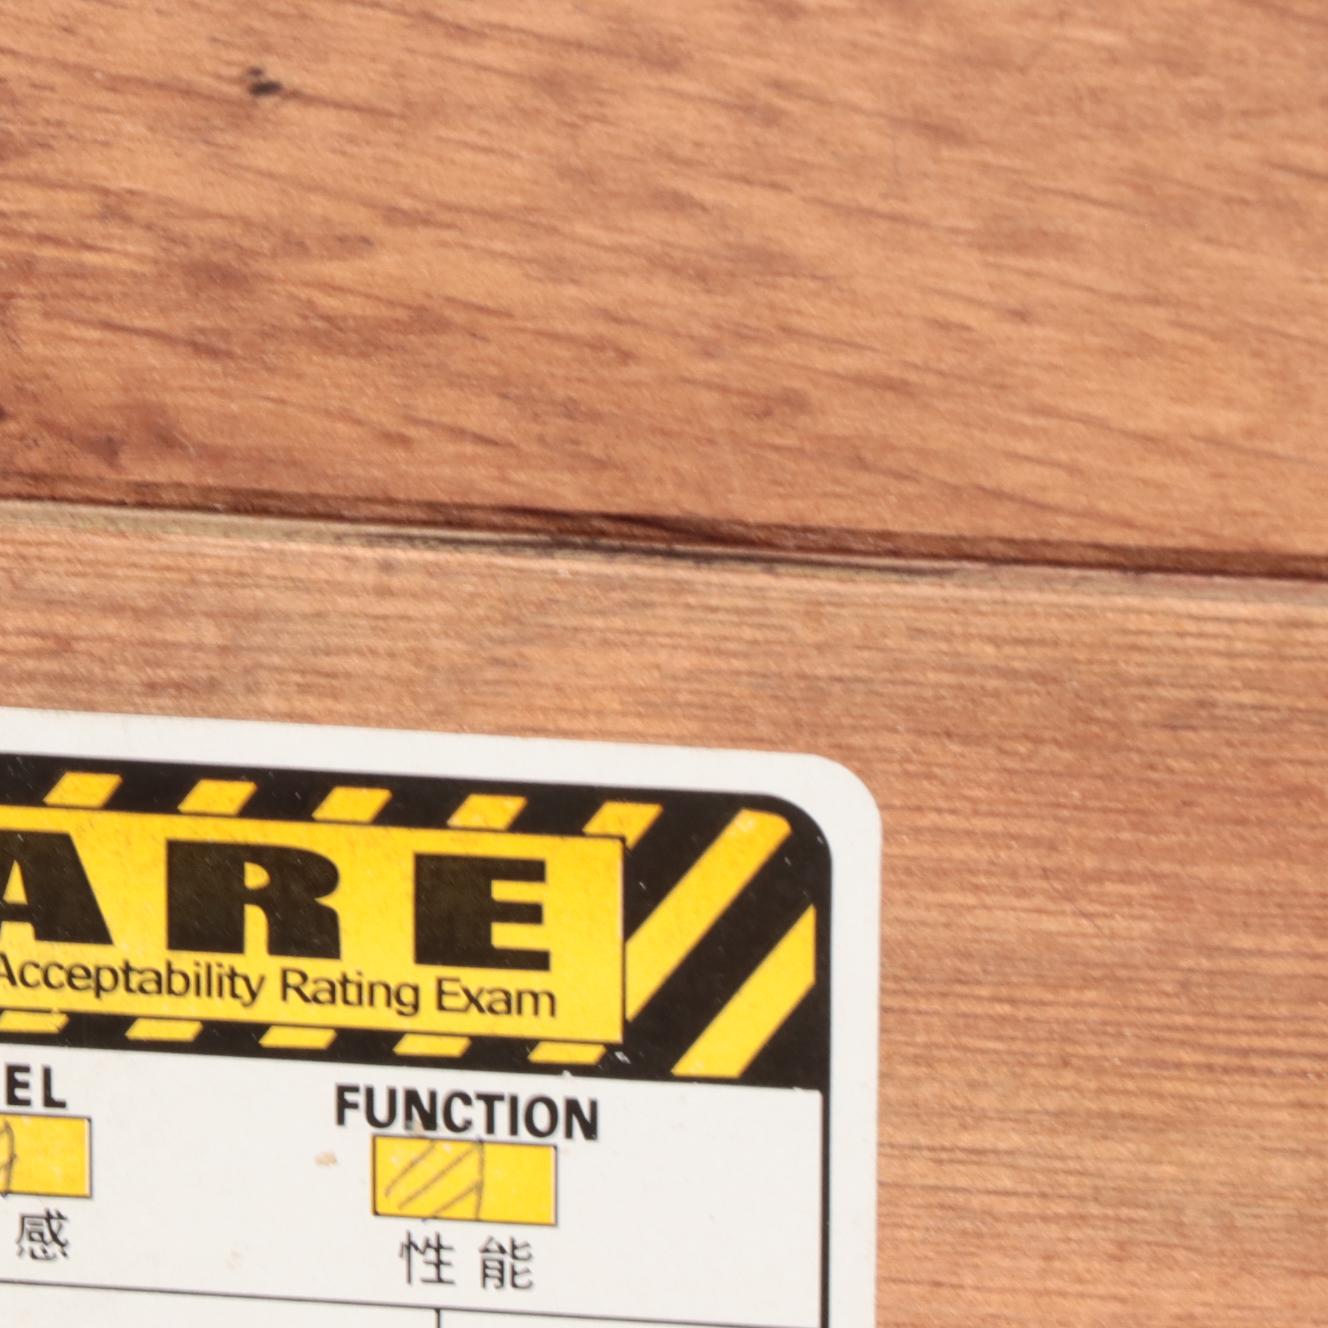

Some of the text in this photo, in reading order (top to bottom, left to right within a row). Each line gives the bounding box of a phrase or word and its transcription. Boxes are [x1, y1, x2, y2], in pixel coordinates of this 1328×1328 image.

[280, 971, 420, 1015] Rating
[435, 977, 556, 1018] Exam
[335, 1083, 600, 1141] FUNCTION
[399, 1232, 534, 1289] 性能
